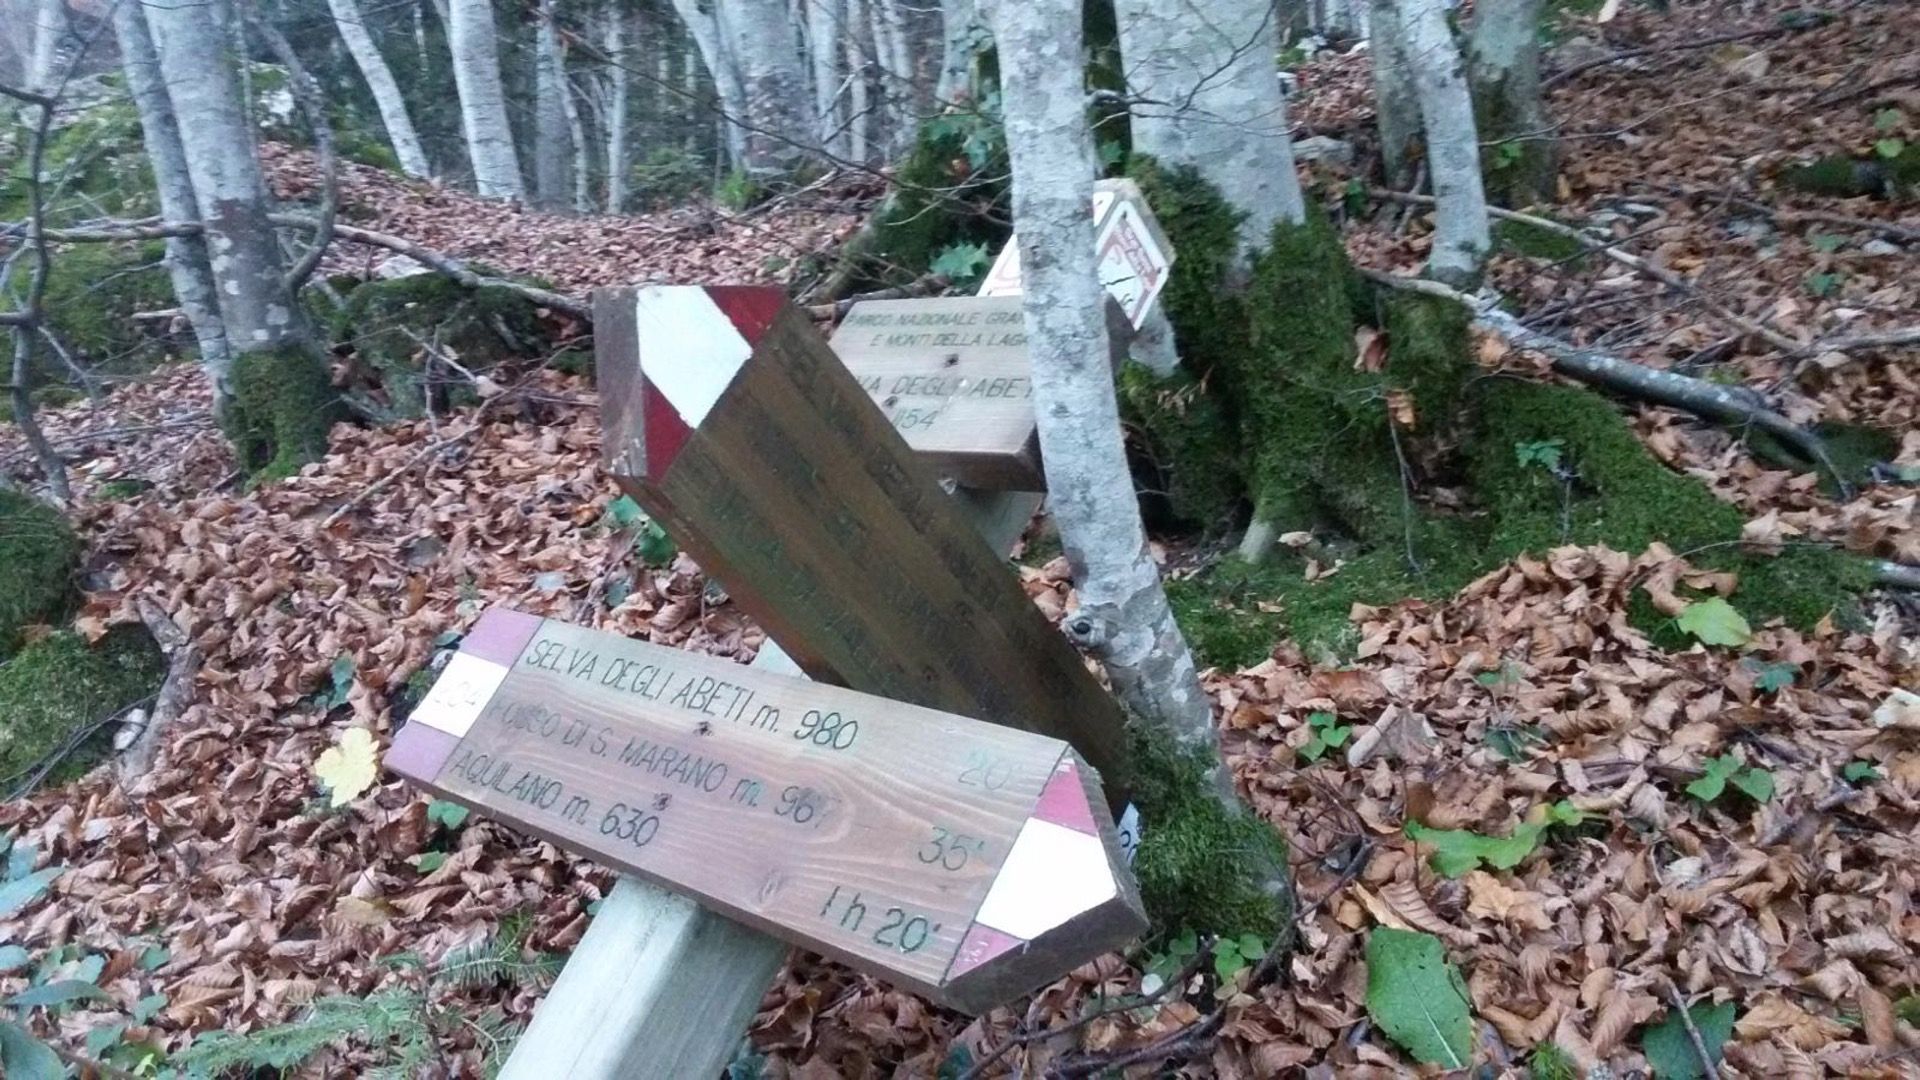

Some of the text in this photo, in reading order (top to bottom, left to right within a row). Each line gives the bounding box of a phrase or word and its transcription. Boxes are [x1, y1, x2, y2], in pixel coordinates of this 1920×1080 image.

[869, 334, 884, 347] E
[932, 333, 981, 347] DELLA
[895, 312, 982, 326] NAZIONALE
[526, 639, 599, 680] SELVA
[601, 658, 675, 700] DEGLI
[670, 676, 755, 722] ABETI
[750, 704, 780, 732] m.
[793, 710, 859, 750] 980
[563, 719, 591, 748] DI
[590, 727, 613, 757] S.
[618, 736, 728, 792] MARANO
[729, 778, 761, 807] m.
[918, 826, 985, 871] 35'
[451, 750, 563, 810] AQUILANO
[600, 802, 660, 846] 630
[840, 892, 867, 932] h
[873, 907, 942, 954] 20'
